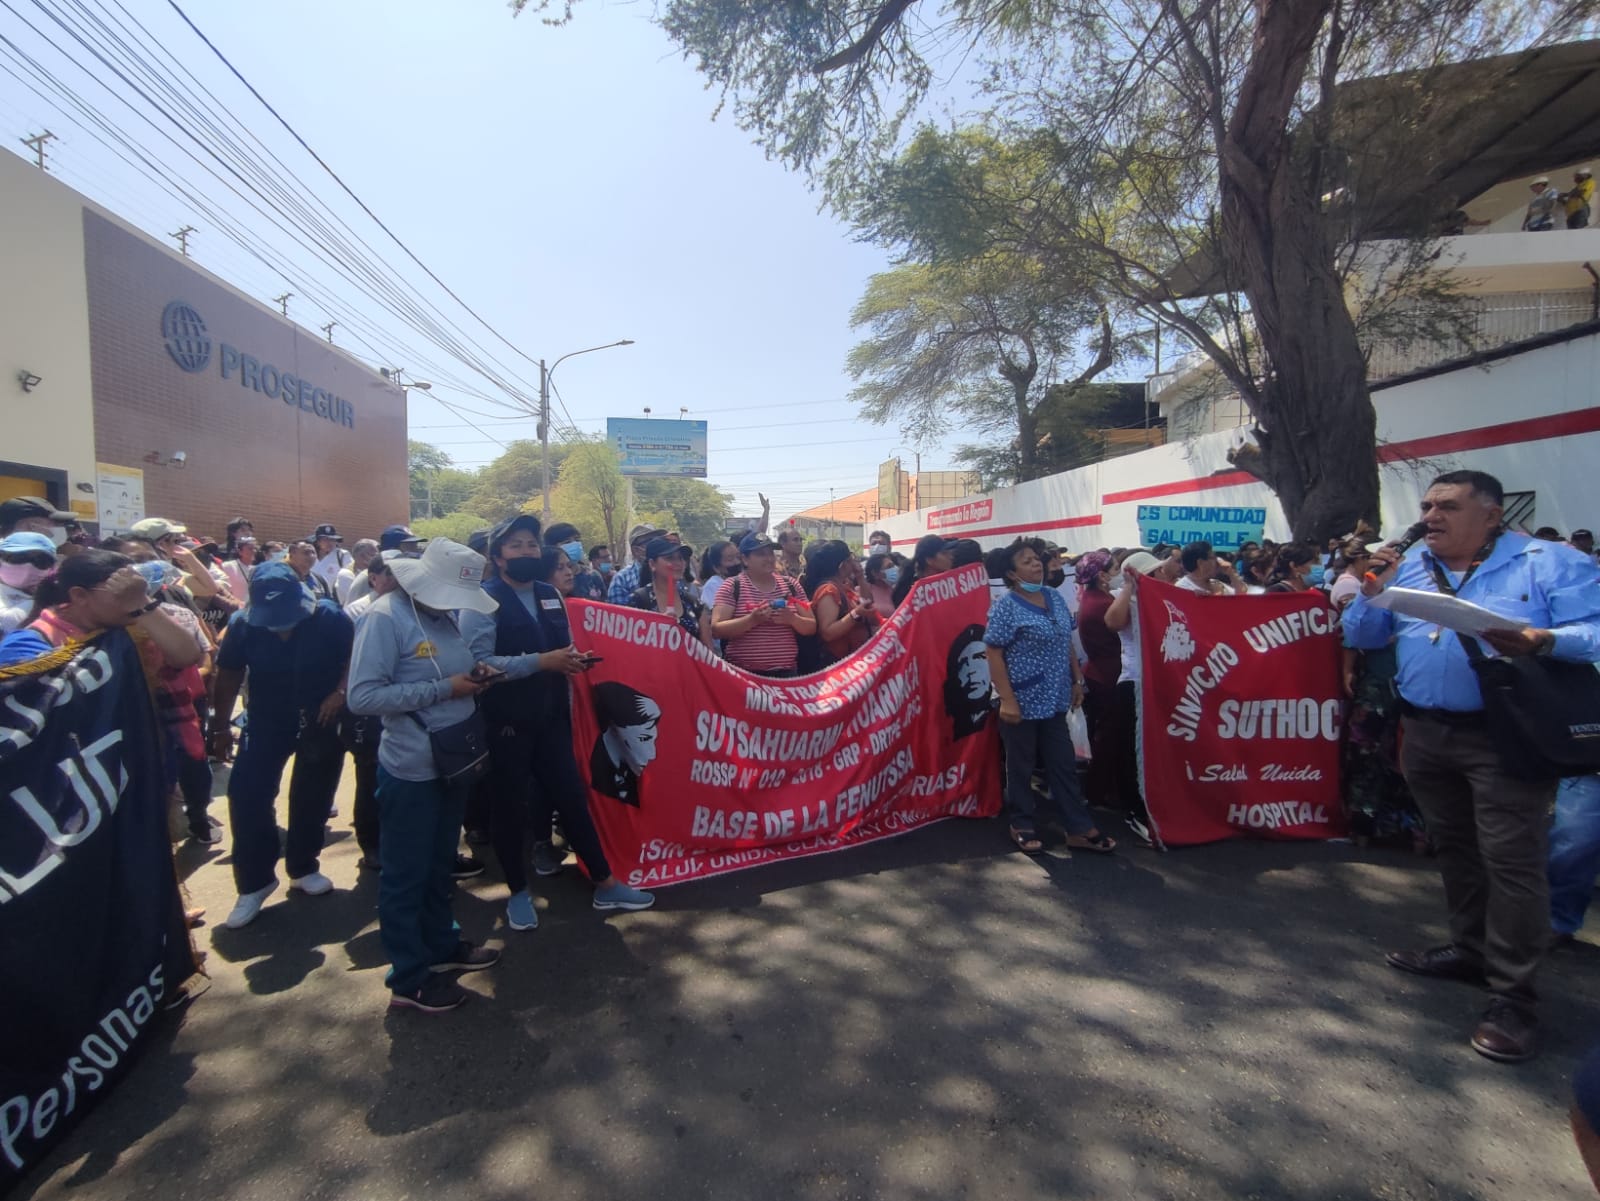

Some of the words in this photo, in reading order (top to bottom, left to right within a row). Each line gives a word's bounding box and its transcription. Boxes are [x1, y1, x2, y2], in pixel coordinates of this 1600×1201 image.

[220, 343, 355, 429] PROSEGUR
[1138, 506, 1160, 521] CS
[1168, 506, 1266, 525] COMUNIDAD
[583, 606, 682, 651] SINDICATO
[803, 695, 844, 716] RED
[1166, 641, 1239, 742] SINDICATO
[690, 759, 738, 788] ROSSP
[833, 742, 860, 772] GRP
[1259, 763, 1323, 782] Unida
[691, 805, 759, 840] BASE
[764, 808, 795, 840] DE
[802, 799, 830, 833] LA
[1226, 800, 1329, 830] HOSPITAL
[0, 963, 165, 1169] Personas
